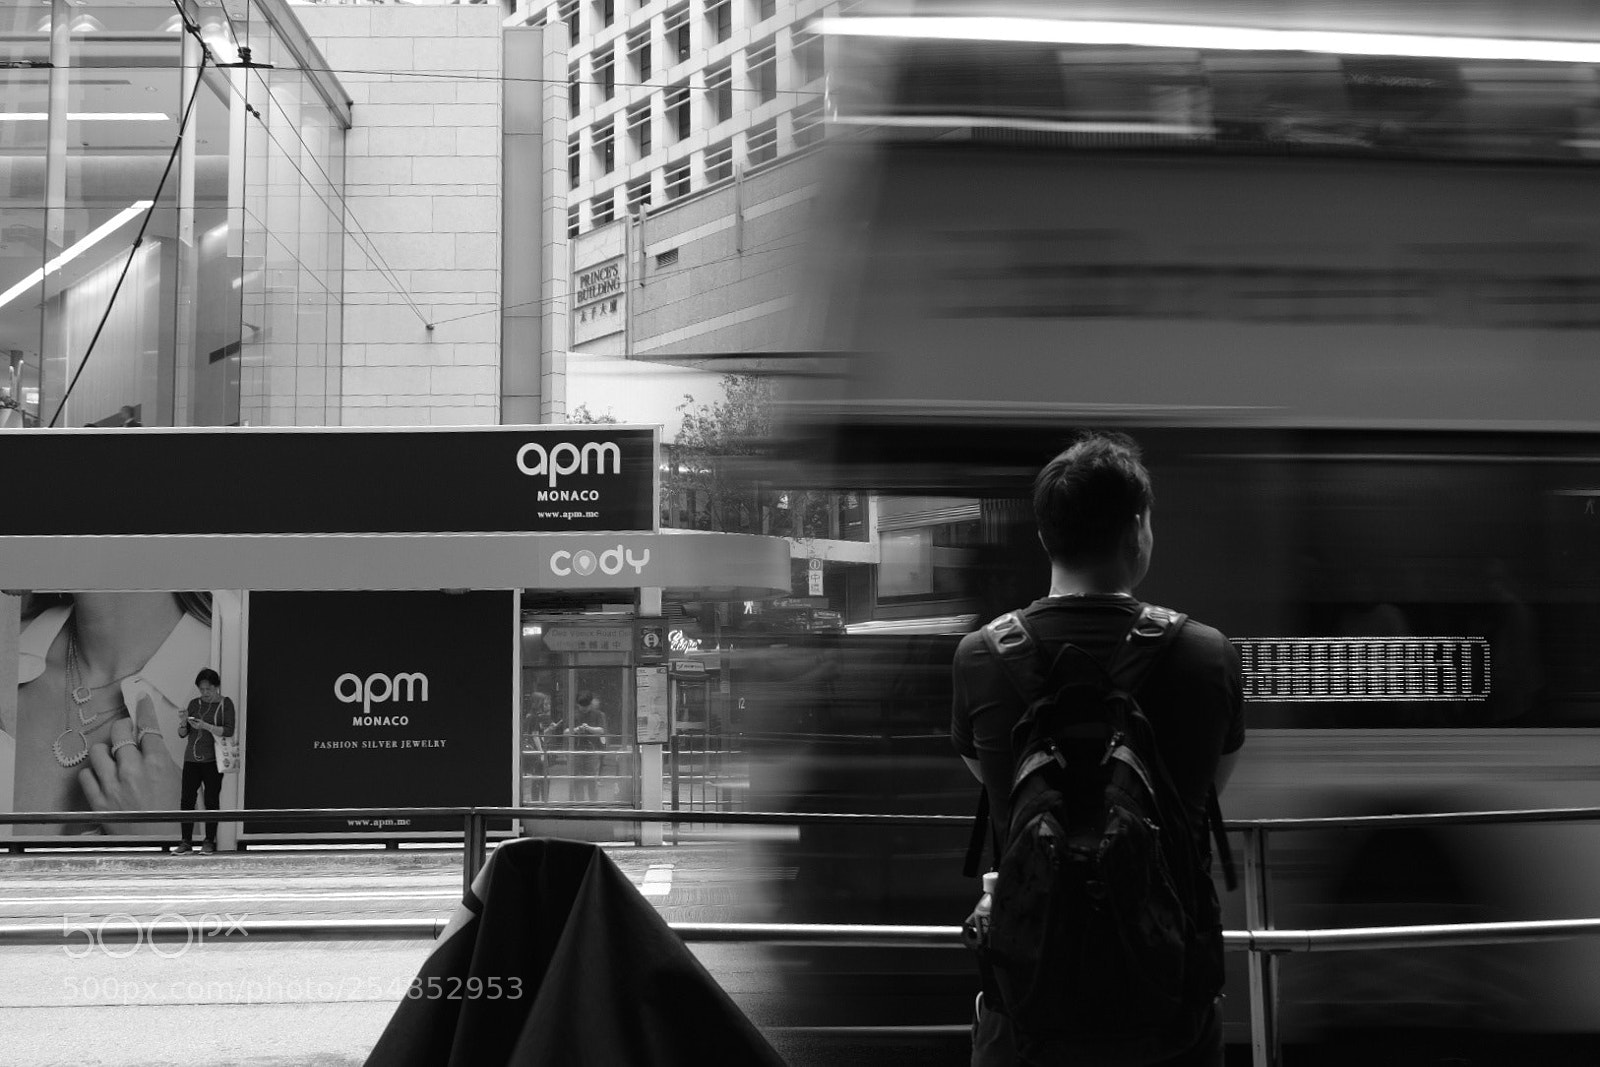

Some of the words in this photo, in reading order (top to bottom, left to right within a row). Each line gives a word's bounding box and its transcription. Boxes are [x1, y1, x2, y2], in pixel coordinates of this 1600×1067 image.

[580, 263, 618, 288] PRINCE'S
[577, 277, 620, 303] BUILDING
[516, 442, 621, 487] apm
[537, 490, 599, 501] MONACO
[537, 511, 599, 520] www.apm.mc
[550, 545, 650, 576] cody
[334, 672, 429, 714] apm
[352, 716, 409, 726] MONACO
[313, 740, 358, 749] FASHION
[361, 740, 398, 748] SILVER
[400, 739, 447, 749] JEWELRY
[347, 818, 411, 829] www.apm.mc
